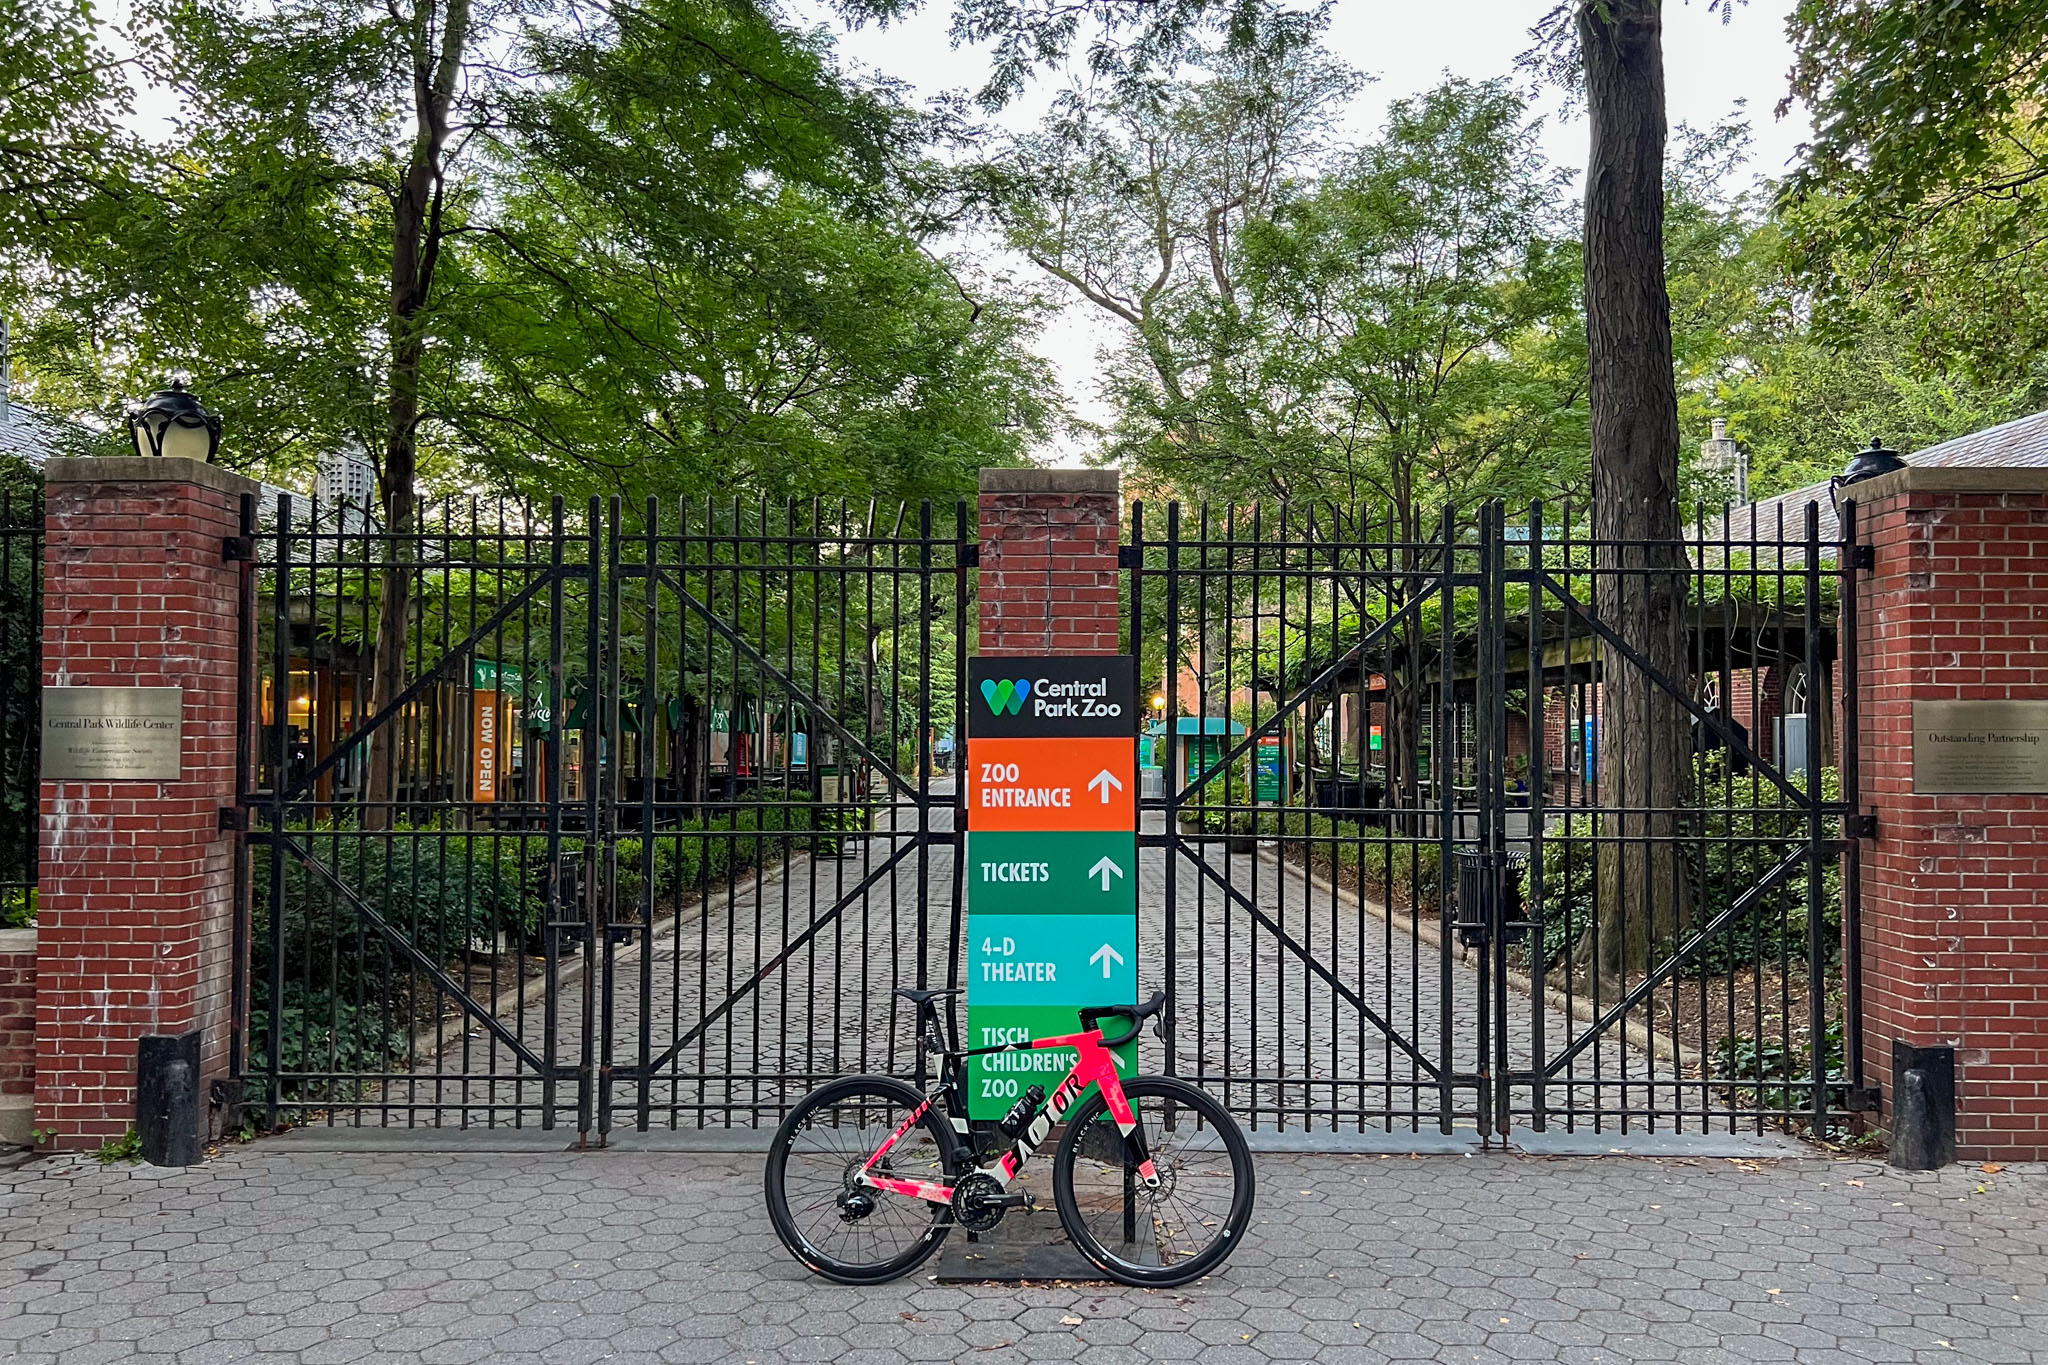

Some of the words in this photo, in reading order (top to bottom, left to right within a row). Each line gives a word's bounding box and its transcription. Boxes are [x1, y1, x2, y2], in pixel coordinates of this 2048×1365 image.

[1033, 677, 1107, 697] Central
[1034, 698, 1079, 717] Park
[1081, 698, 1122, 717] Zoo
[48, 718, 82, 729] Central
[83, 718, 104, 729] Park
[105, 718, 142, 729] Wildlife
[143, 718, 175, 729] Center
[481, 706, 493, 744] NOW
[1928, 732, 1986, 745] Outstanding
[1987, 732, 2040, 745] Partnership
[479, 747, 493, 791] OPEN
[981, 763, 1020, 783] ZOO
[981, 787, 1071, 808] ENTRANCE
[981, 862, 1050, 882] TICKETS
[981, 937, 1016, 956] 4-D
[981, 962, 1057, 982] THEATER
[981, 1027, 1029, 1046] TISCH
[981, 1053, 1078, 1072] CHILDREN'S
[981, 1078, 1018, 1098] ZOO
[787, 1118, 807, 1145] BLACK
[807, 1105, 820, 1119] INC
[1000, 1073, 1086, 1180] FACTOR
[1072, 1124, 1090, 1153] BLACK
[1089, 1110, 1101, 1125] INC
